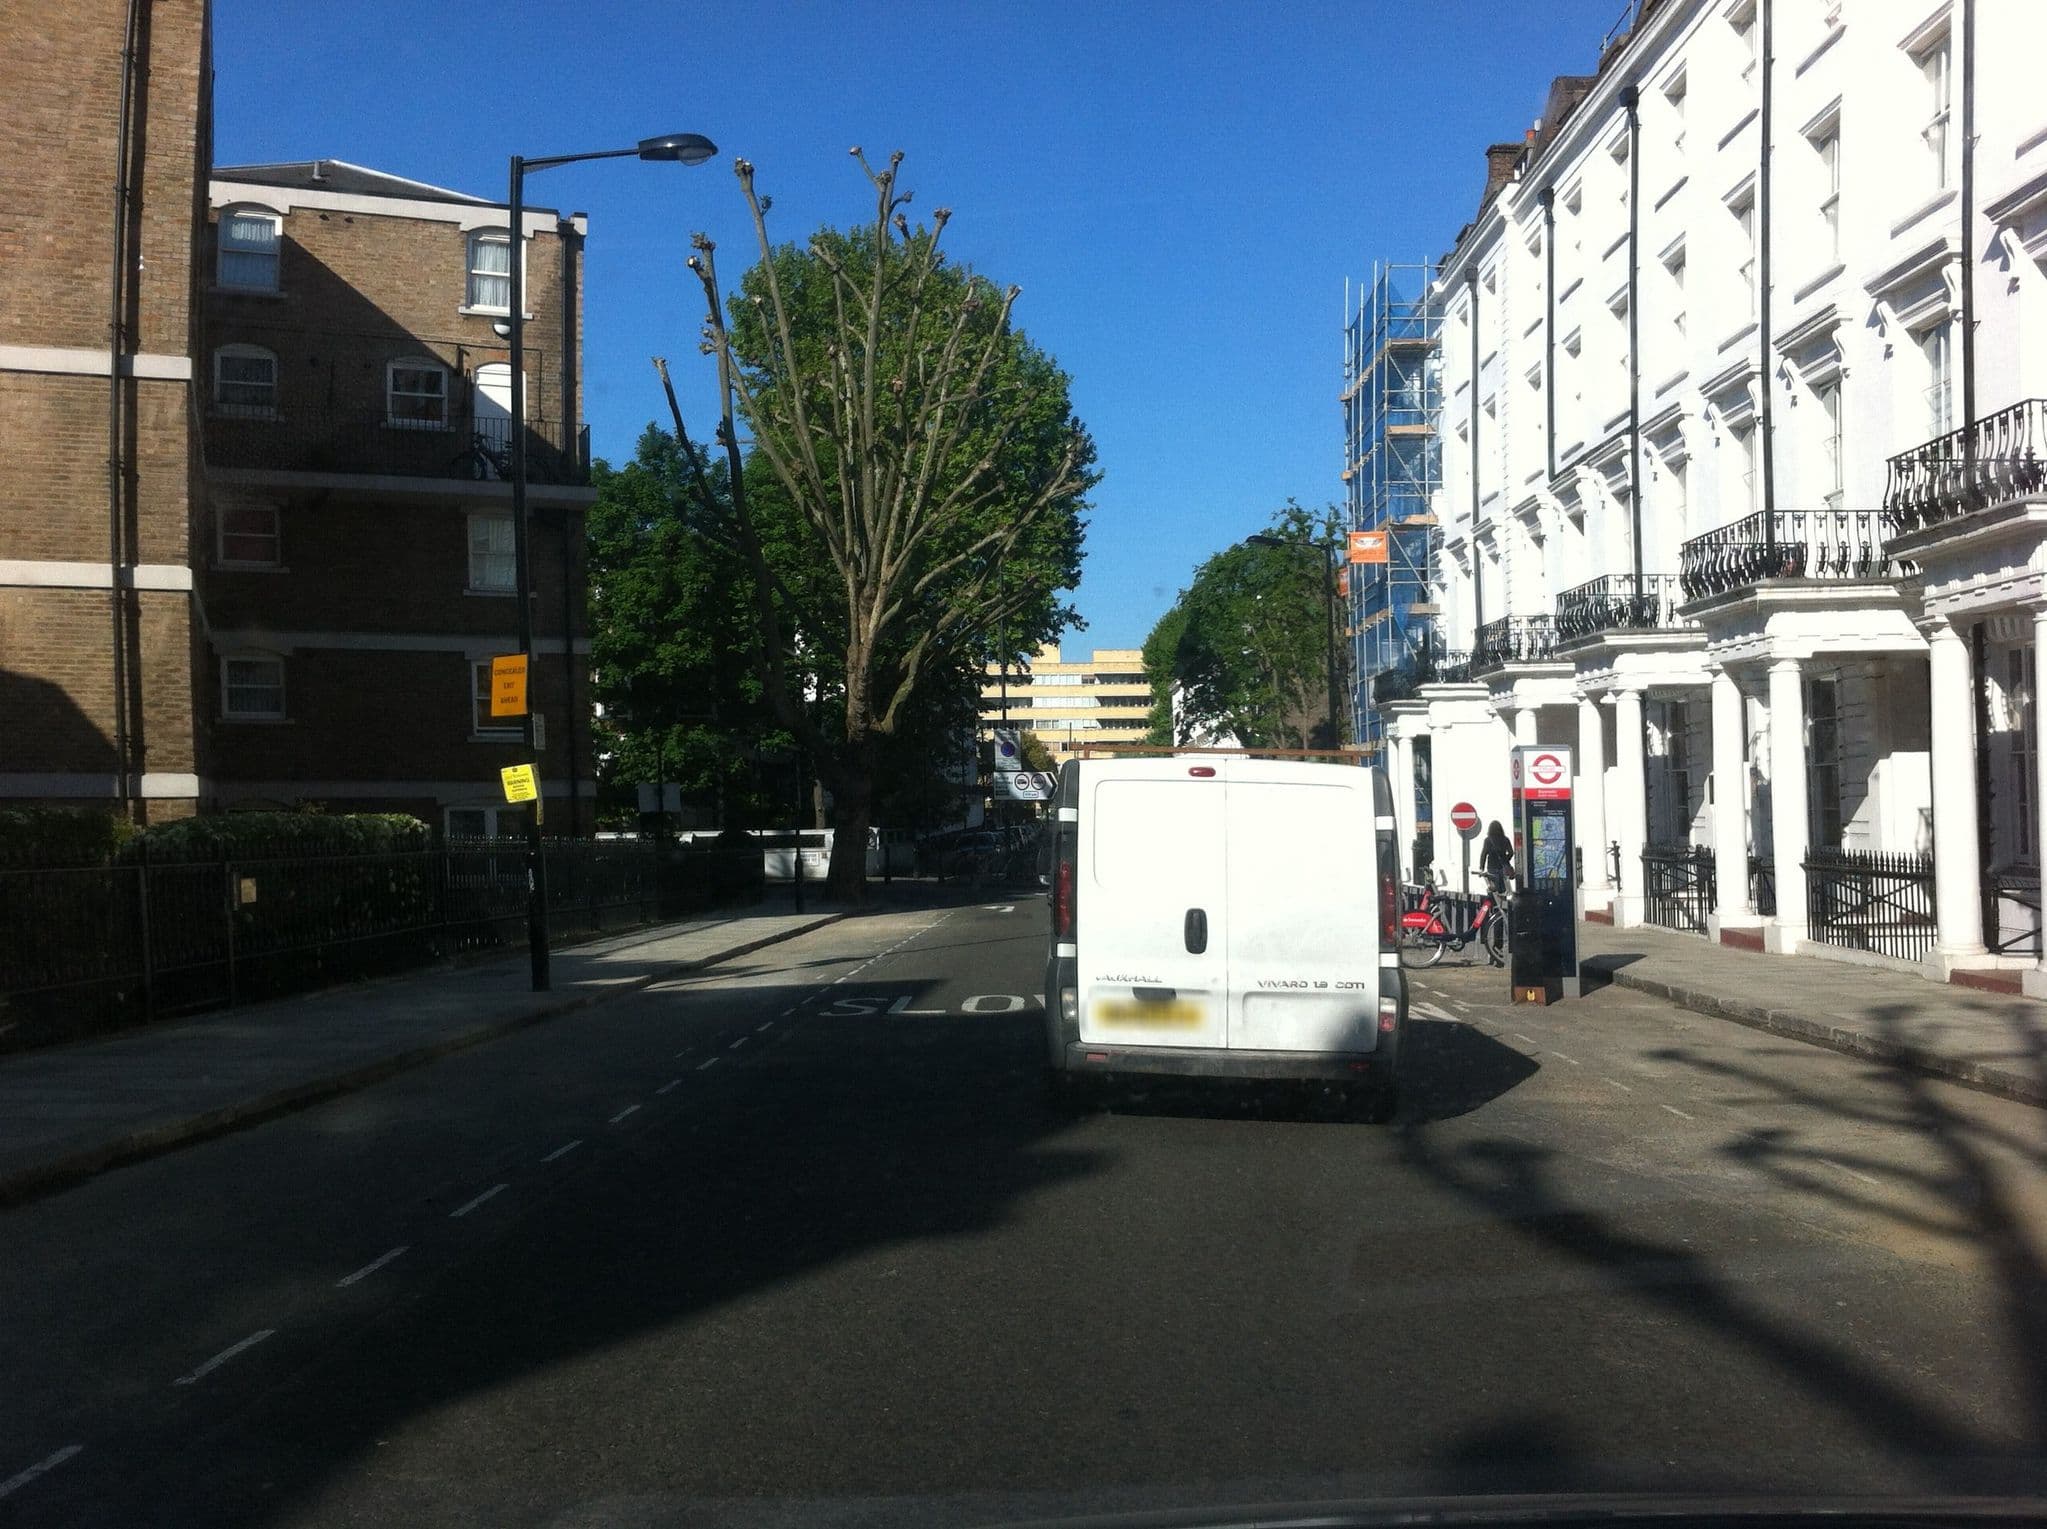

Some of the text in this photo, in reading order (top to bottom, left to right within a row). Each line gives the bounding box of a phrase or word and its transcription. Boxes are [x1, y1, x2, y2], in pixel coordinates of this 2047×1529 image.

[1257, 979, 1309, 989] VIVARO
[1335, 981, 1365, 990] CDTI
[818, 993, 1046, 1017] SLO
